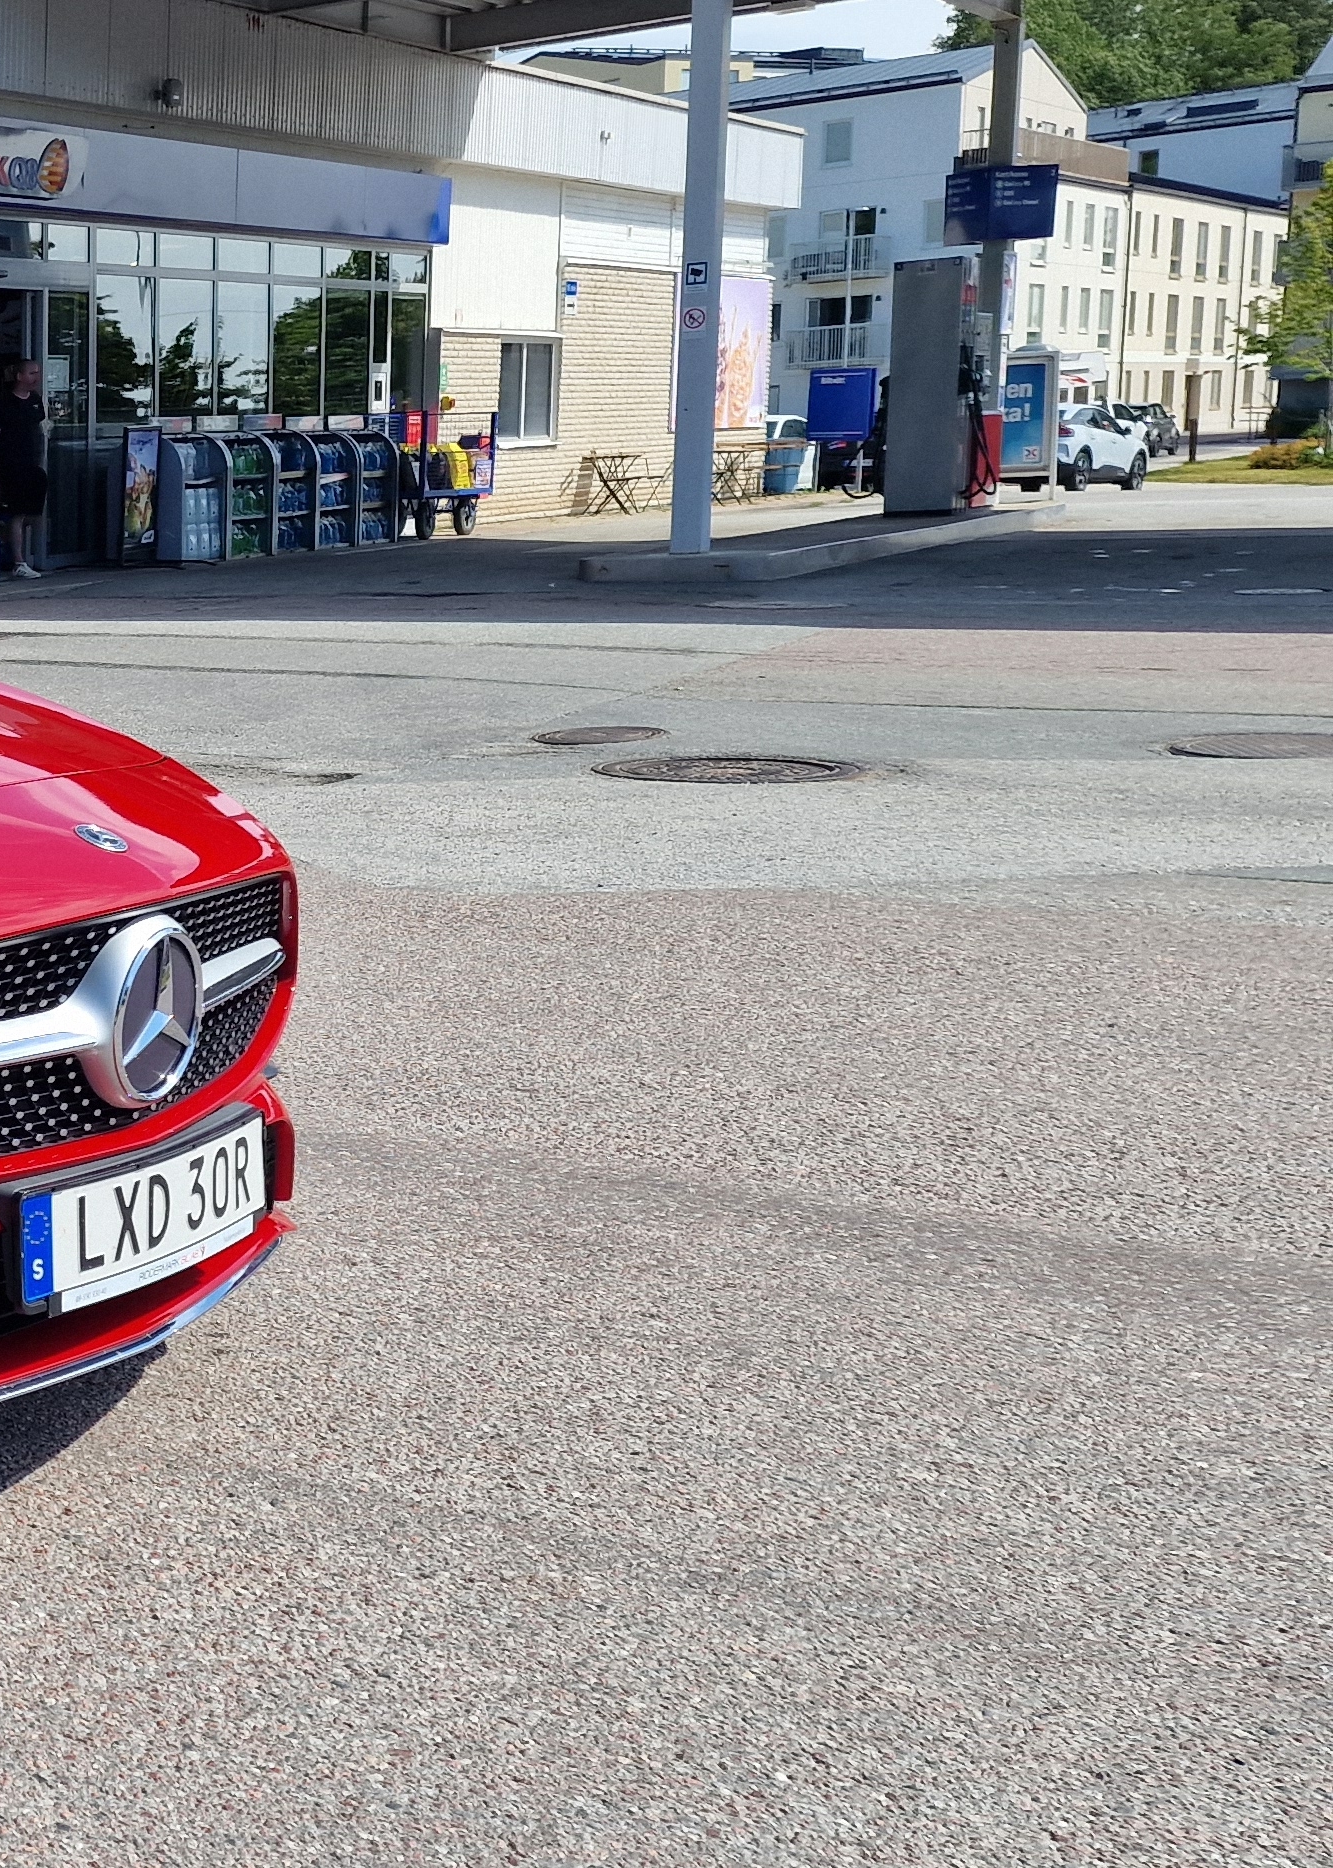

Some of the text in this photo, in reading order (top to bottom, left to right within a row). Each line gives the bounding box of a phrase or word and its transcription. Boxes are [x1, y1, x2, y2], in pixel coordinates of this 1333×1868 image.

[77, 1136, 251, 1273] LXD 30R
[32, 1258, 45, 1281] S
